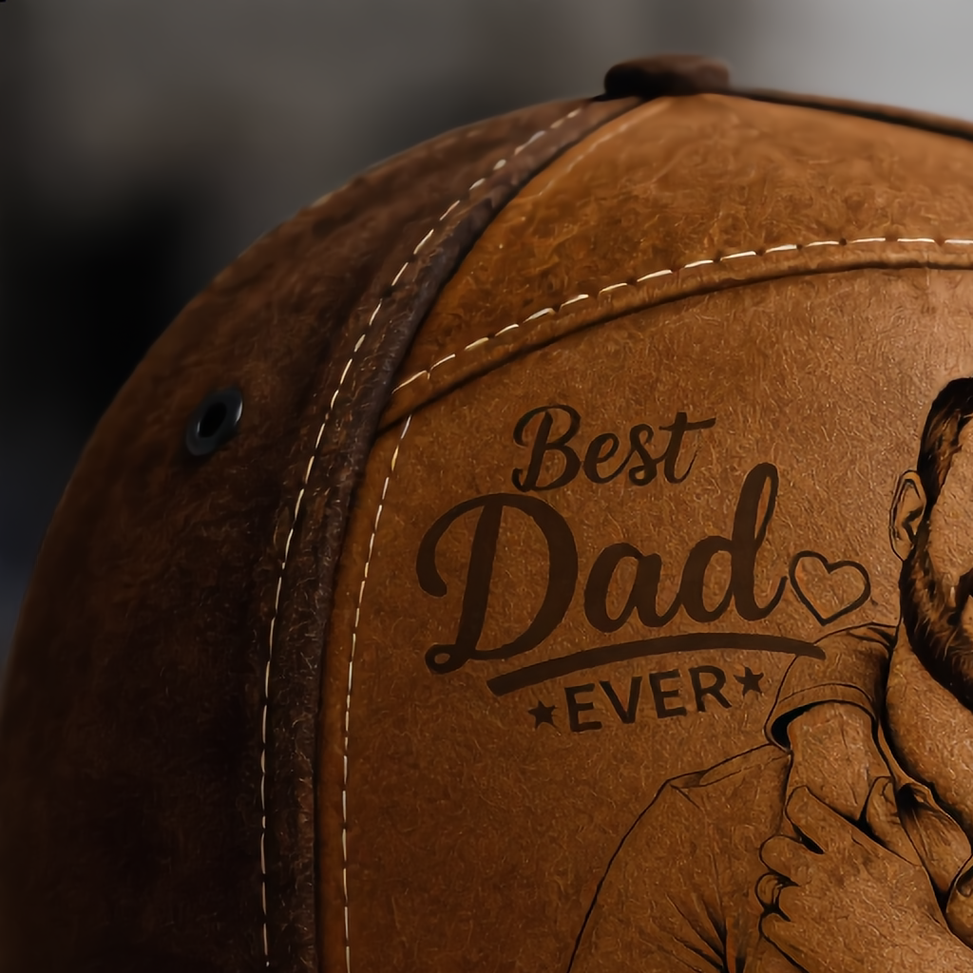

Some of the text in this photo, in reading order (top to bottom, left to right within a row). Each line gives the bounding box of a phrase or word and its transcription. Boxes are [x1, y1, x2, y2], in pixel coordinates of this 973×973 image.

[511, 404, 717, 492] Best
[416, 462, 789, 675] Dad
[564, 665, 733, 733] EVER
